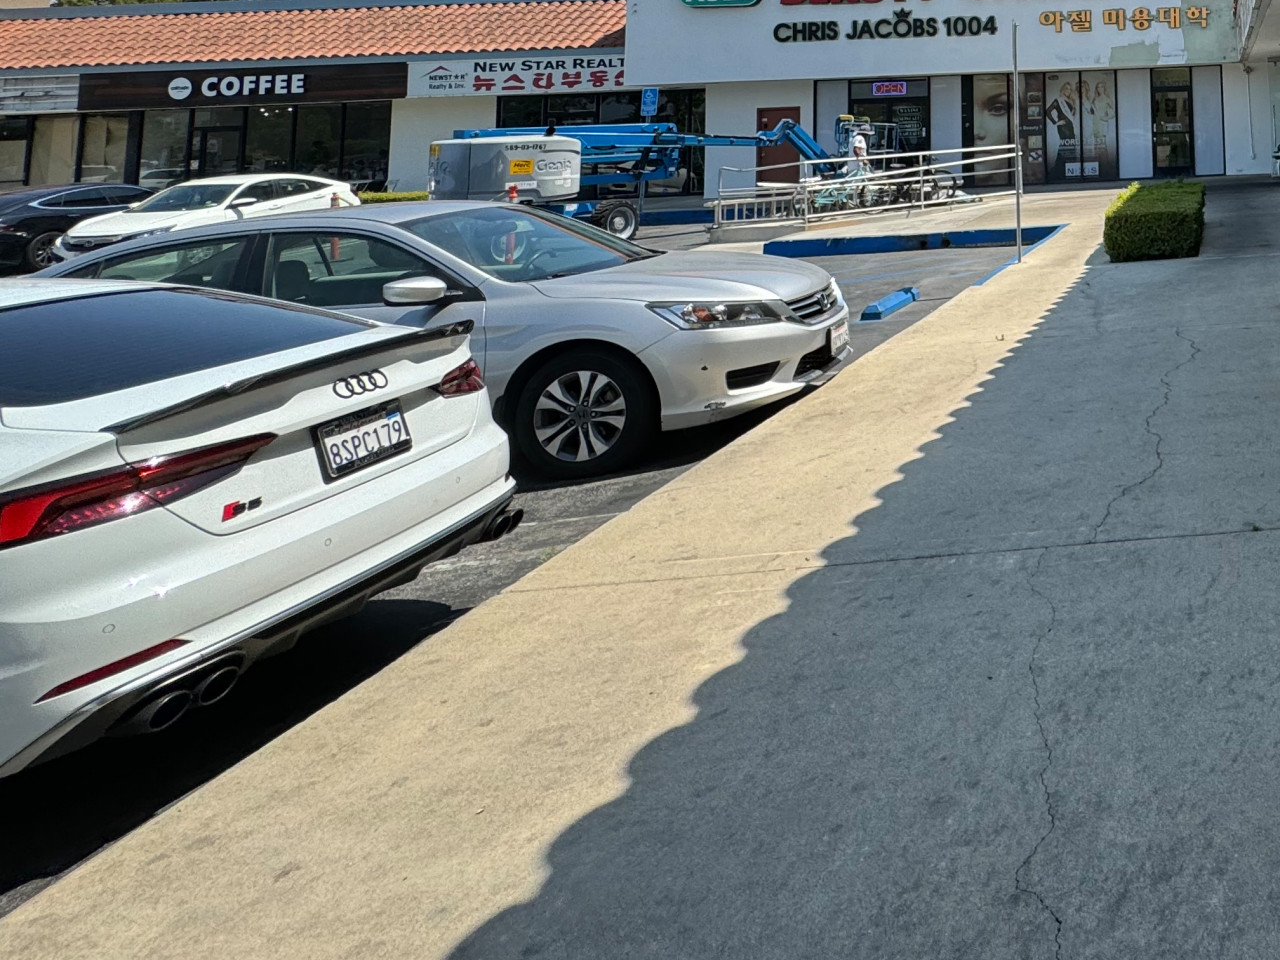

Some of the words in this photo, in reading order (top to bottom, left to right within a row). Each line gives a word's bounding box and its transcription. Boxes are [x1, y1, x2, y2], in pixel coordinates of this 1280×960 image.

[773, 20, 839, 42] CHRIS
[846, 17, 938, 40] JACOBS
[942, 15, 998, 37] 1004
[1039, 10, 1092, 33] 아젤
[1102, 6, 1210, 30] 미용대학
[473, 61, 515, 73] NEW
[521, 60, 565, 71] STAR
[201, 74, 305, 97] COFFEE
[875, 84, 904, 94] OPEN
[536, 159, 571, 172] Genie
[329, 419, 402, 468] 8SPC179
